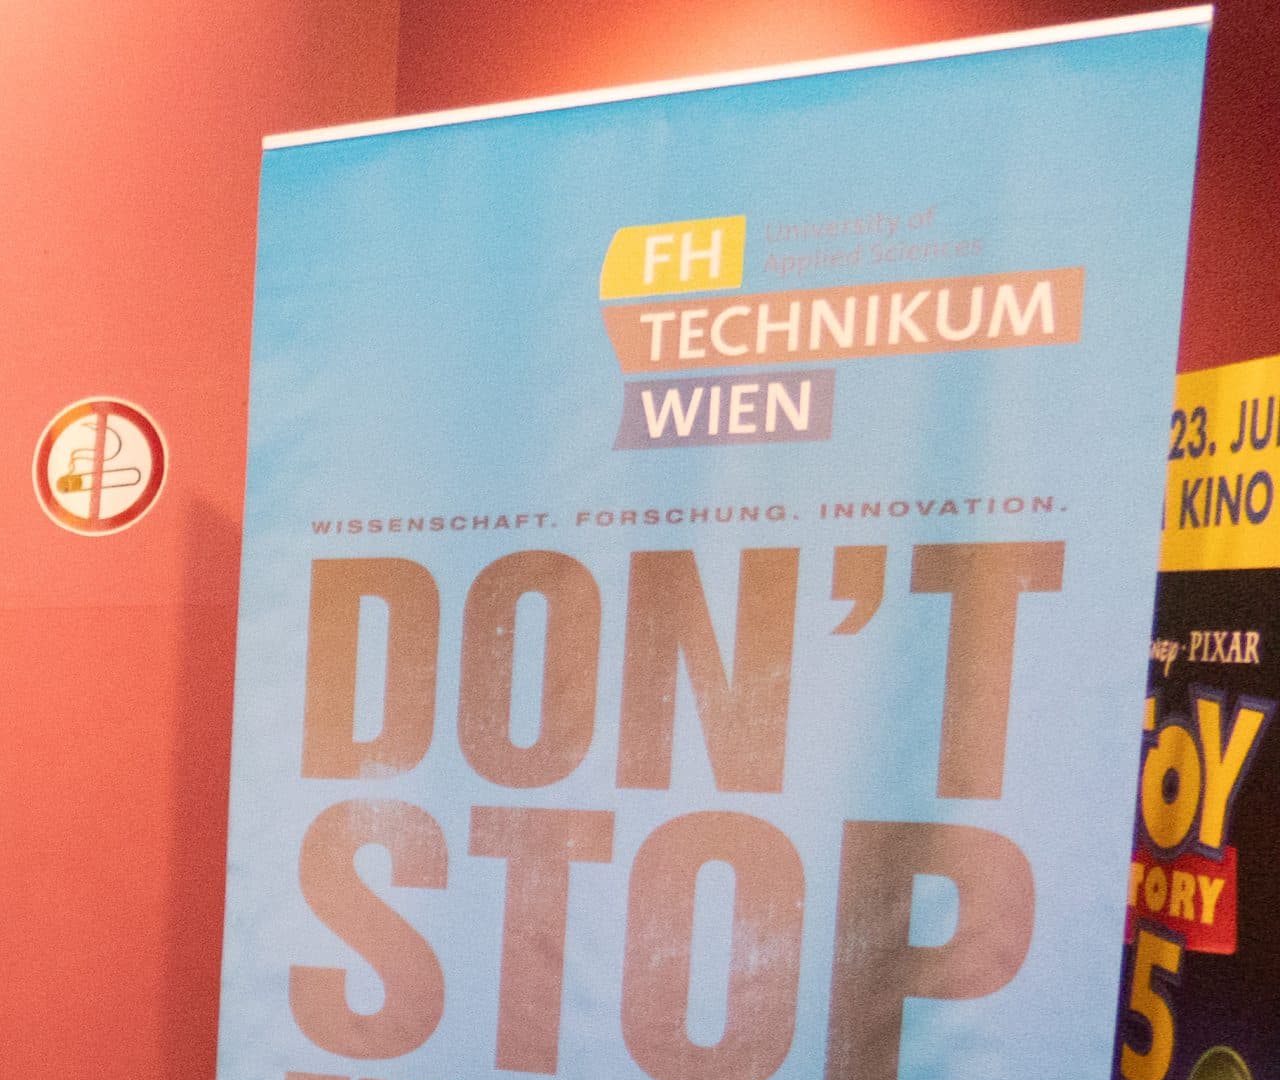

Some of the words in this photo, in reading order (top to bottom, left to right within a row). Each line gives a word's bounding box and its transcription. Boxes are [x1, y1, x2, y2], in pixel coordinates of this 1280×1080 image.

[763, 210, 900, 244] University
[906, 204, 937, 231] of
[643, 228, 724, 286] FH
[762, 240, 863, 279] Applied
[870, 236, 985, 265] Sciences
[640, 280, 1057, 362] TECHNIKUM
[640, 379, 812, 439] WIEN
[1168, 405, 1216, 461] 23.
[311, 512, 559, 535] WISSENSCHAFT.
[575, 503, 800, 527] FORSCHUNG.
[820, 495, 1069, 521] INNOVATION.
[1180, 468, 1275, 530] KINO
[300, 540, 1067, 800] DON’T
[1188, 629, 1260, 664] PIXAR
[1141, 696, 1266, 849] OY
